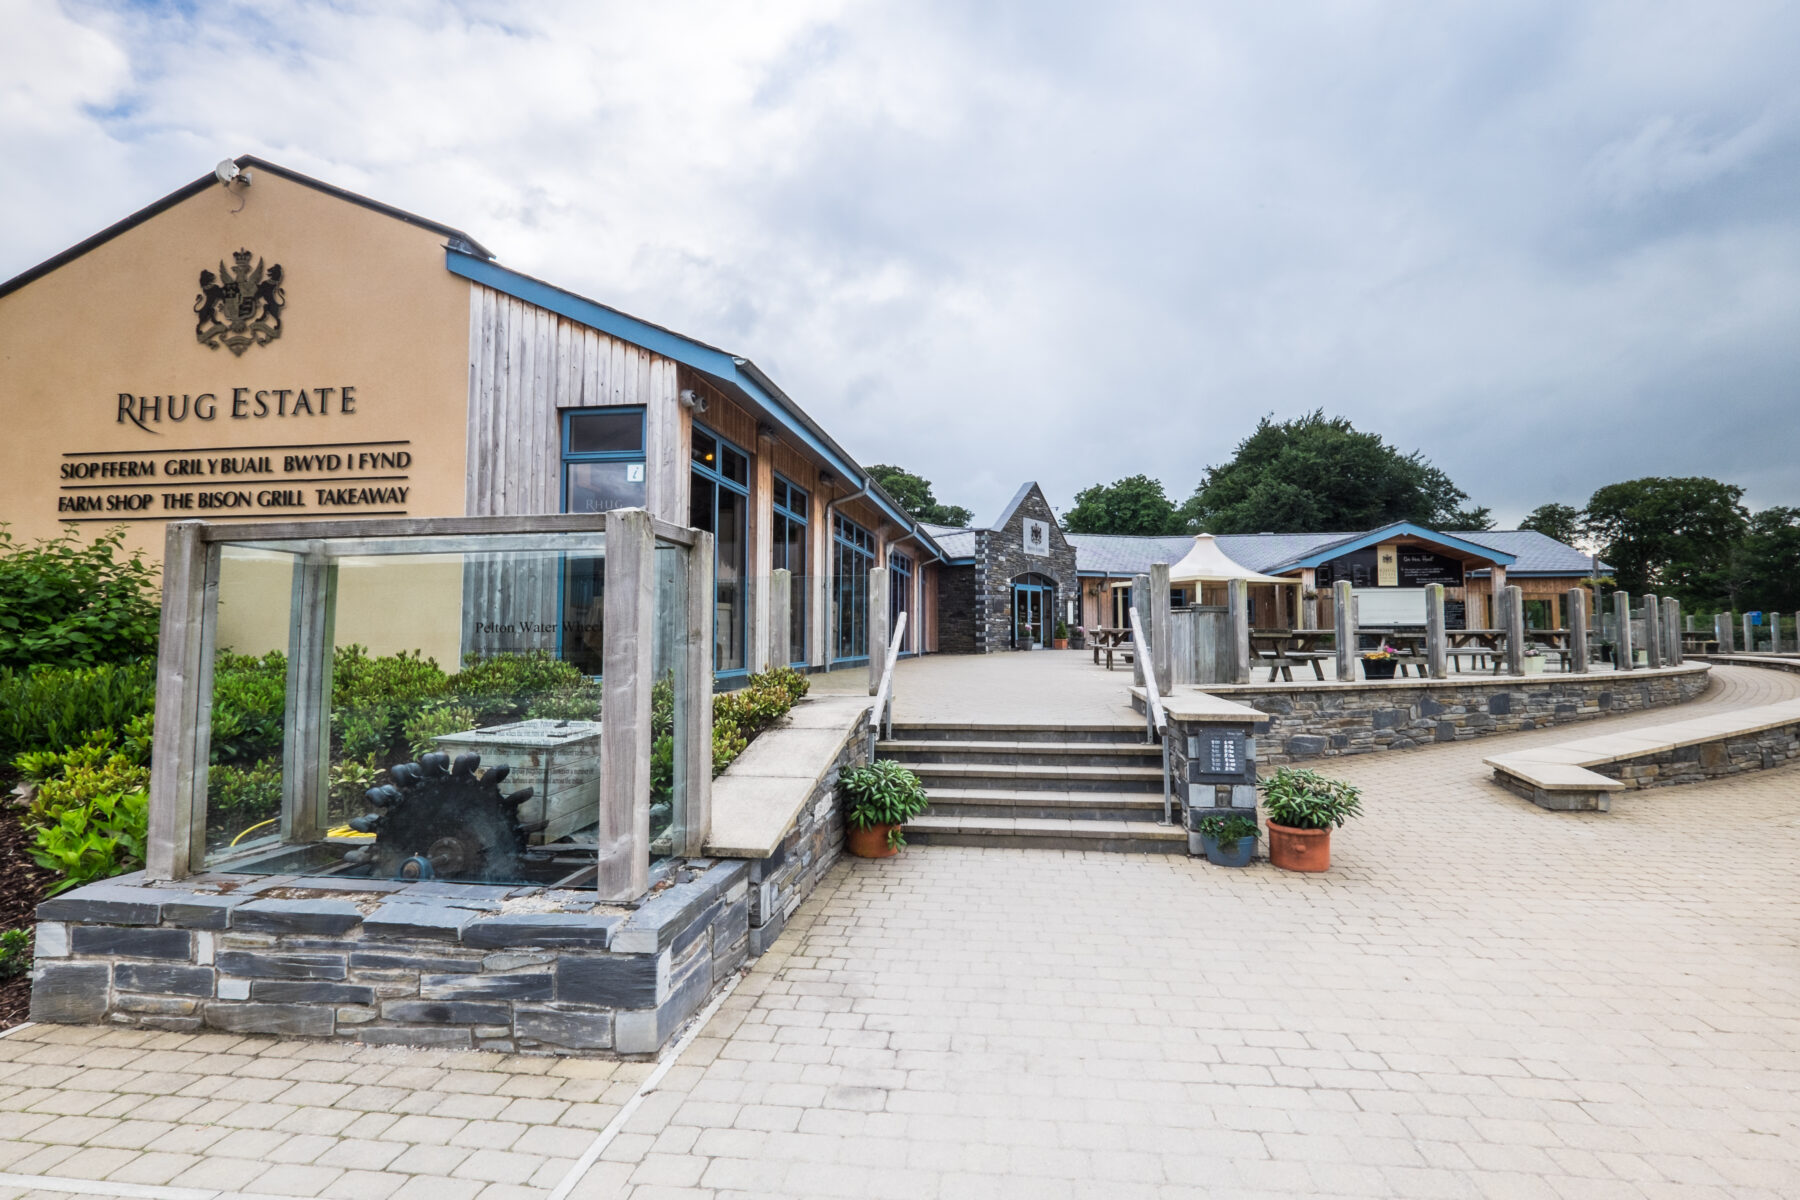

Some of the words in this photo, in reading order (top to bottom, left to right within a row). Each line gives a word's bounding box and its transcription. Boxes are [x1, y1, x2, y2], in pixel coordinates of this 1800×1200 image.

[116, 392, 217, 434] RHUG
[231, 386, 357, 419] ESTATE
[163, 458, 205, 477] GRIL
[220, 456, 273, 475] BUAIL
[283, 454, 342, 473] BWYD
[347, 453, 353, 471] I
[358, 451, 412, 470] FYND
[58, 495, 103, 513] FARM
[106, 493, 154, 512] SHOP
[161, 492, 194, 510] THE
[197, 490, 252, 509] BISON
[256, 489, 306, 508] GRILL
[315, 486, 410, 506] TAKEAWAY
[585, 499, 623, 513] RHUG
[475, 621, 515, 633] Pelton
[520, 621, 558, 633] Water
[562, 620, 603, 633] Wheel
